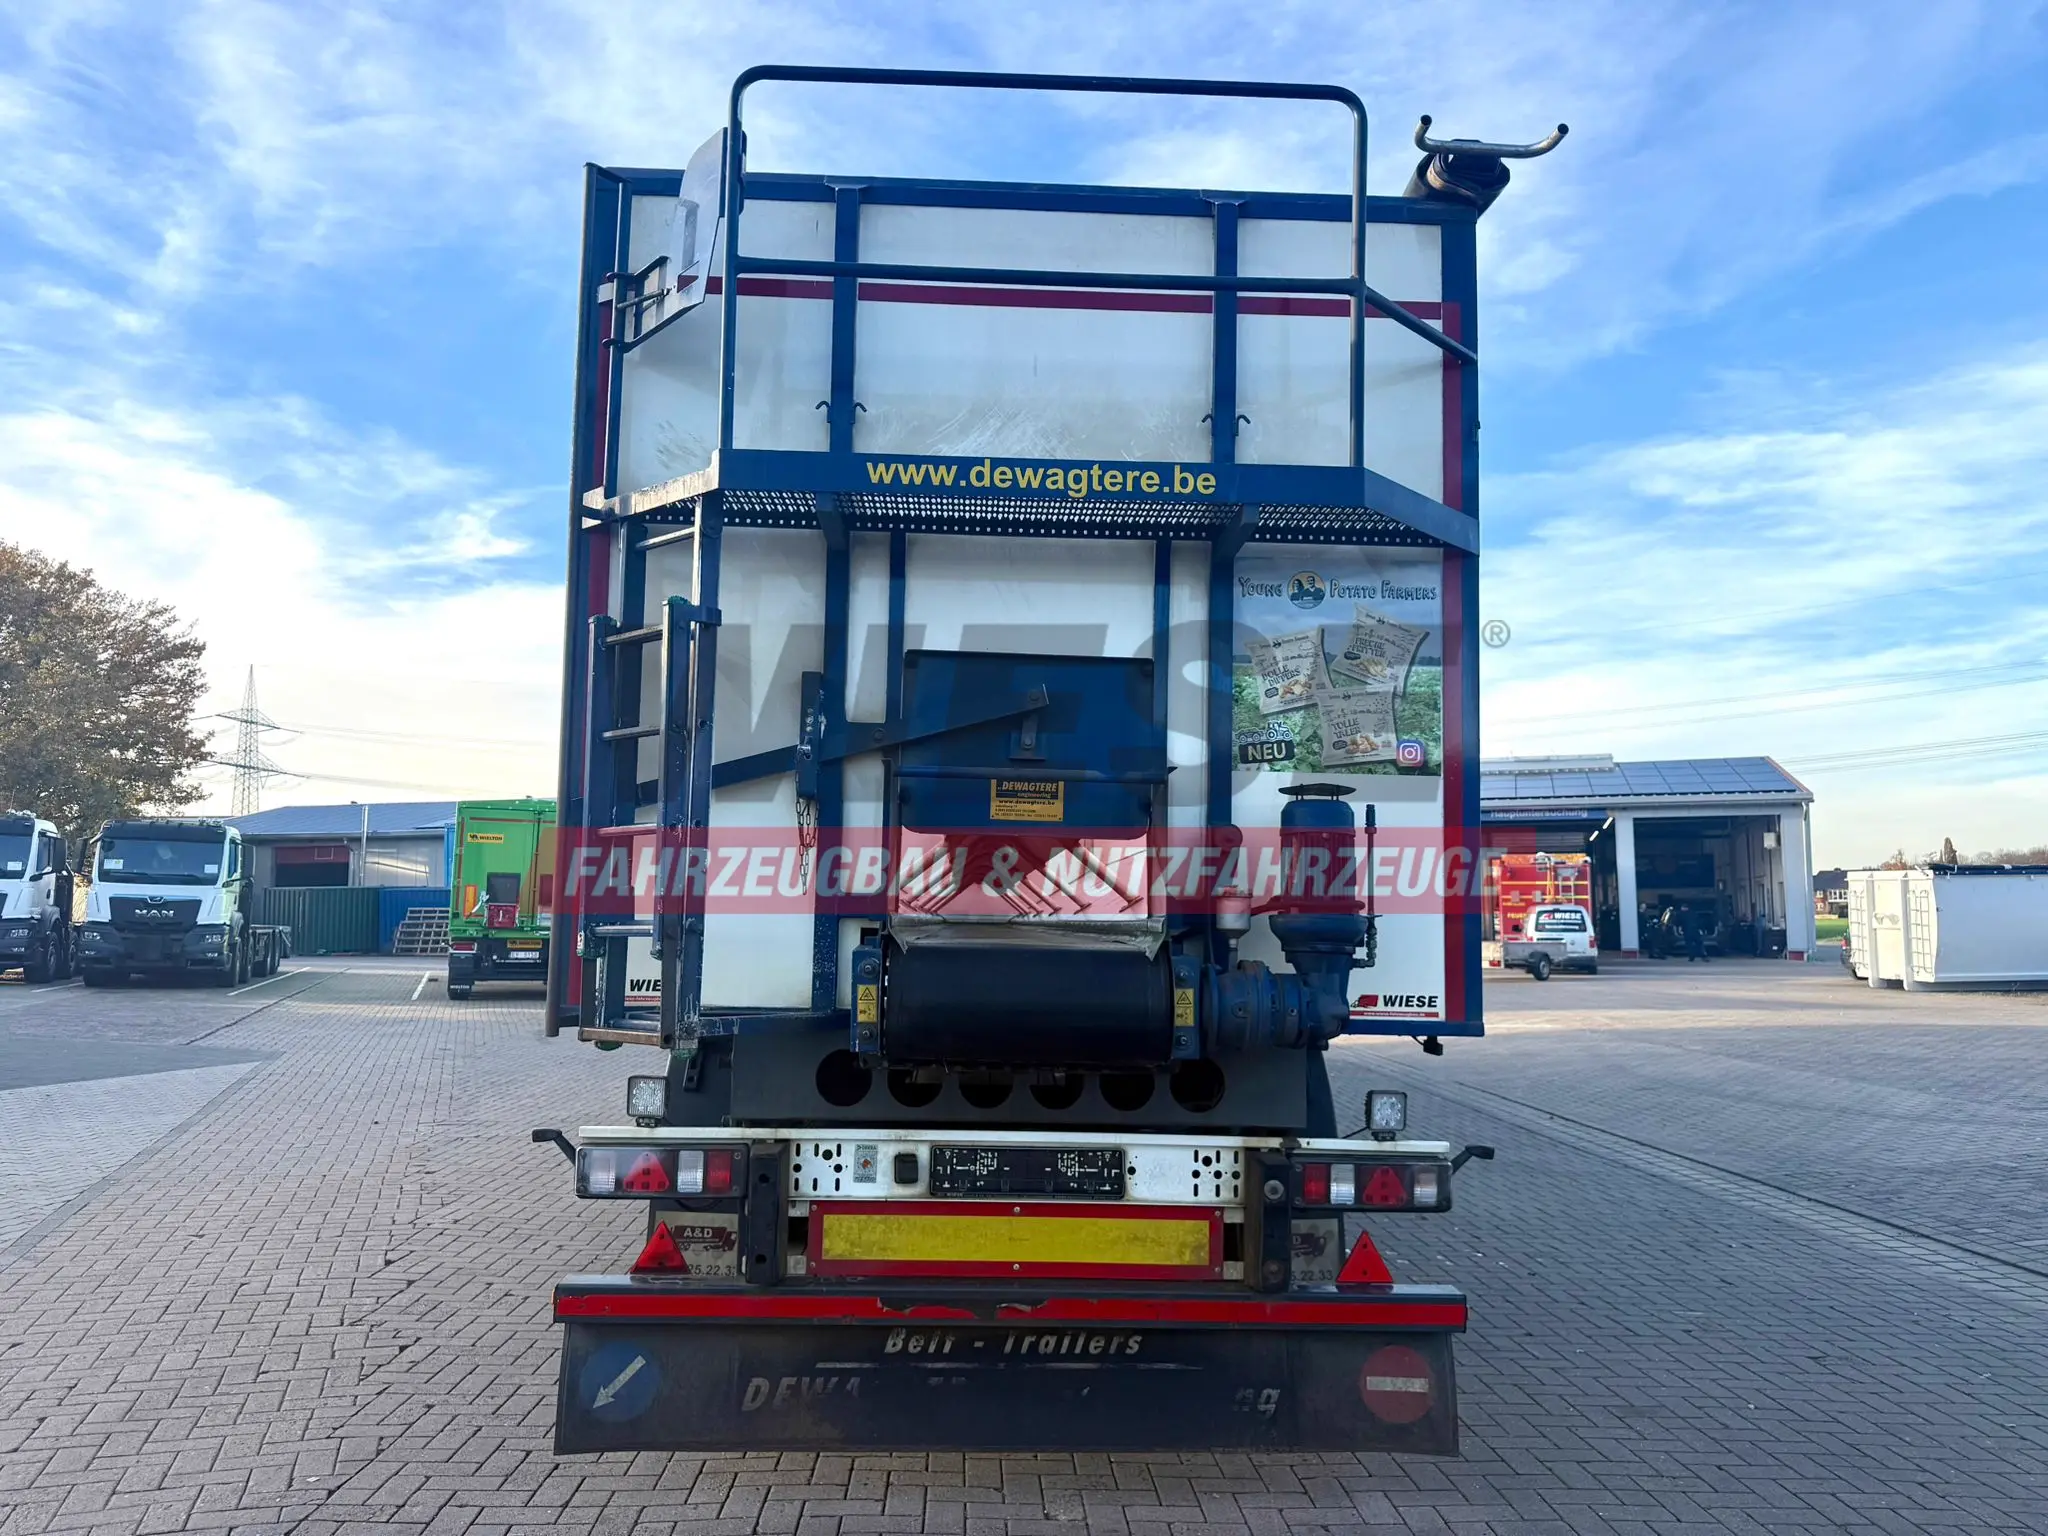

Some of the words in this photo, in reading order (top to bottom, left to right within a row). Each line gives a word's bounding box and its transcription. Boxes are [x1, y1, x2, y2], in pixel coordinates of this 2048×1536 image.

[866, 459, 1217, 498] www.dewagtere.be
[1247, 742, 1287, 761] NEU
[1002, 781, 1058, 792] DEWAGTERE
[135, 909, 175, 918] MAN
[1383, 994, 1439, 1008] WIESE
[683, 1227, 713, 1238] A&D
